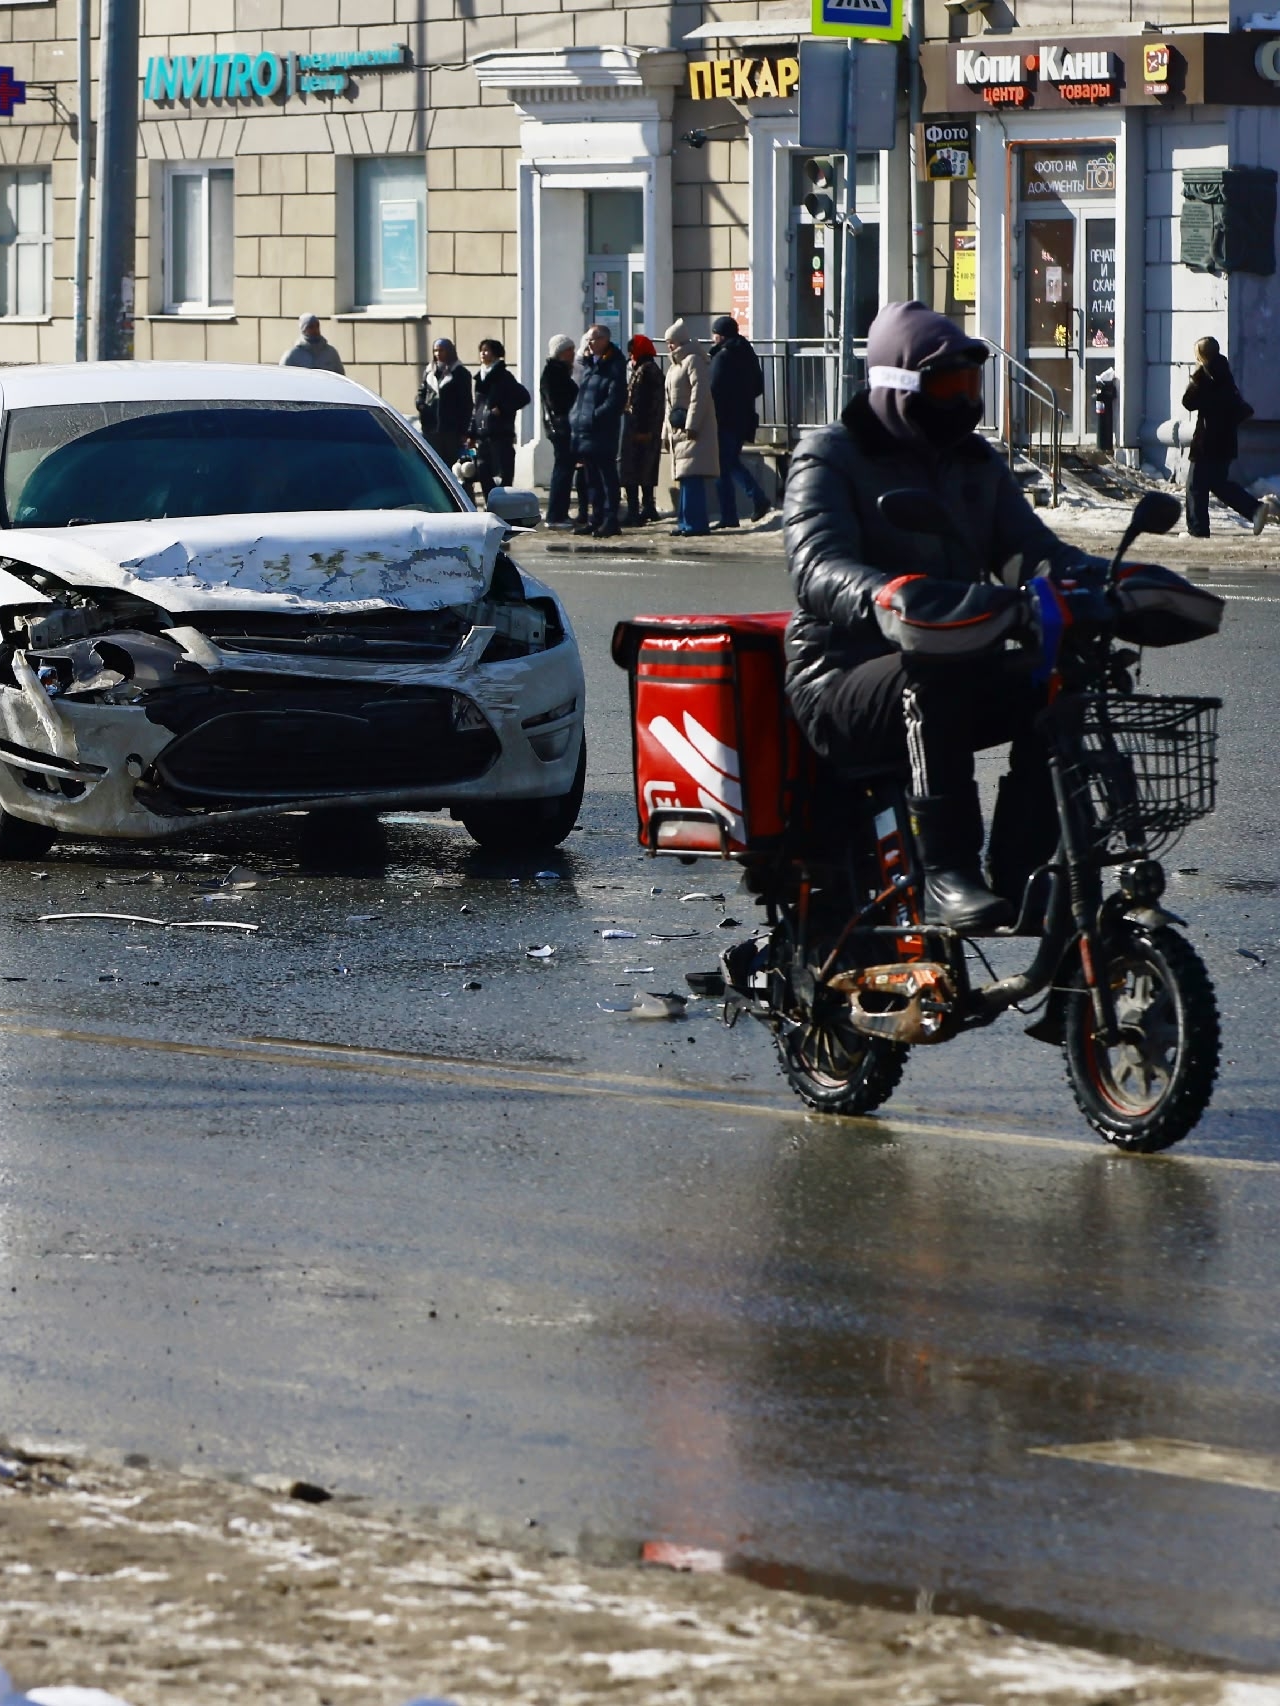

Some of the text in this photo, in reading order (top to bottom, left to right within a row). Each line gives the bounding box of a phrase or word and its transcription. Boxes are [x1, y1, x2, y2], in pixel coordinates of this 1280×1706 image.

[144, 51, 280, 100] INVITRO
[300, 73, 346, 95] центр
[984, 83, 1110, 105] центр товары
[1034, 160, 1078, 174] ФОТО НА
[1027, 179, 1085, 194] ДОКУМЕНТЫ
[1100, 263, 1108, 277] И
